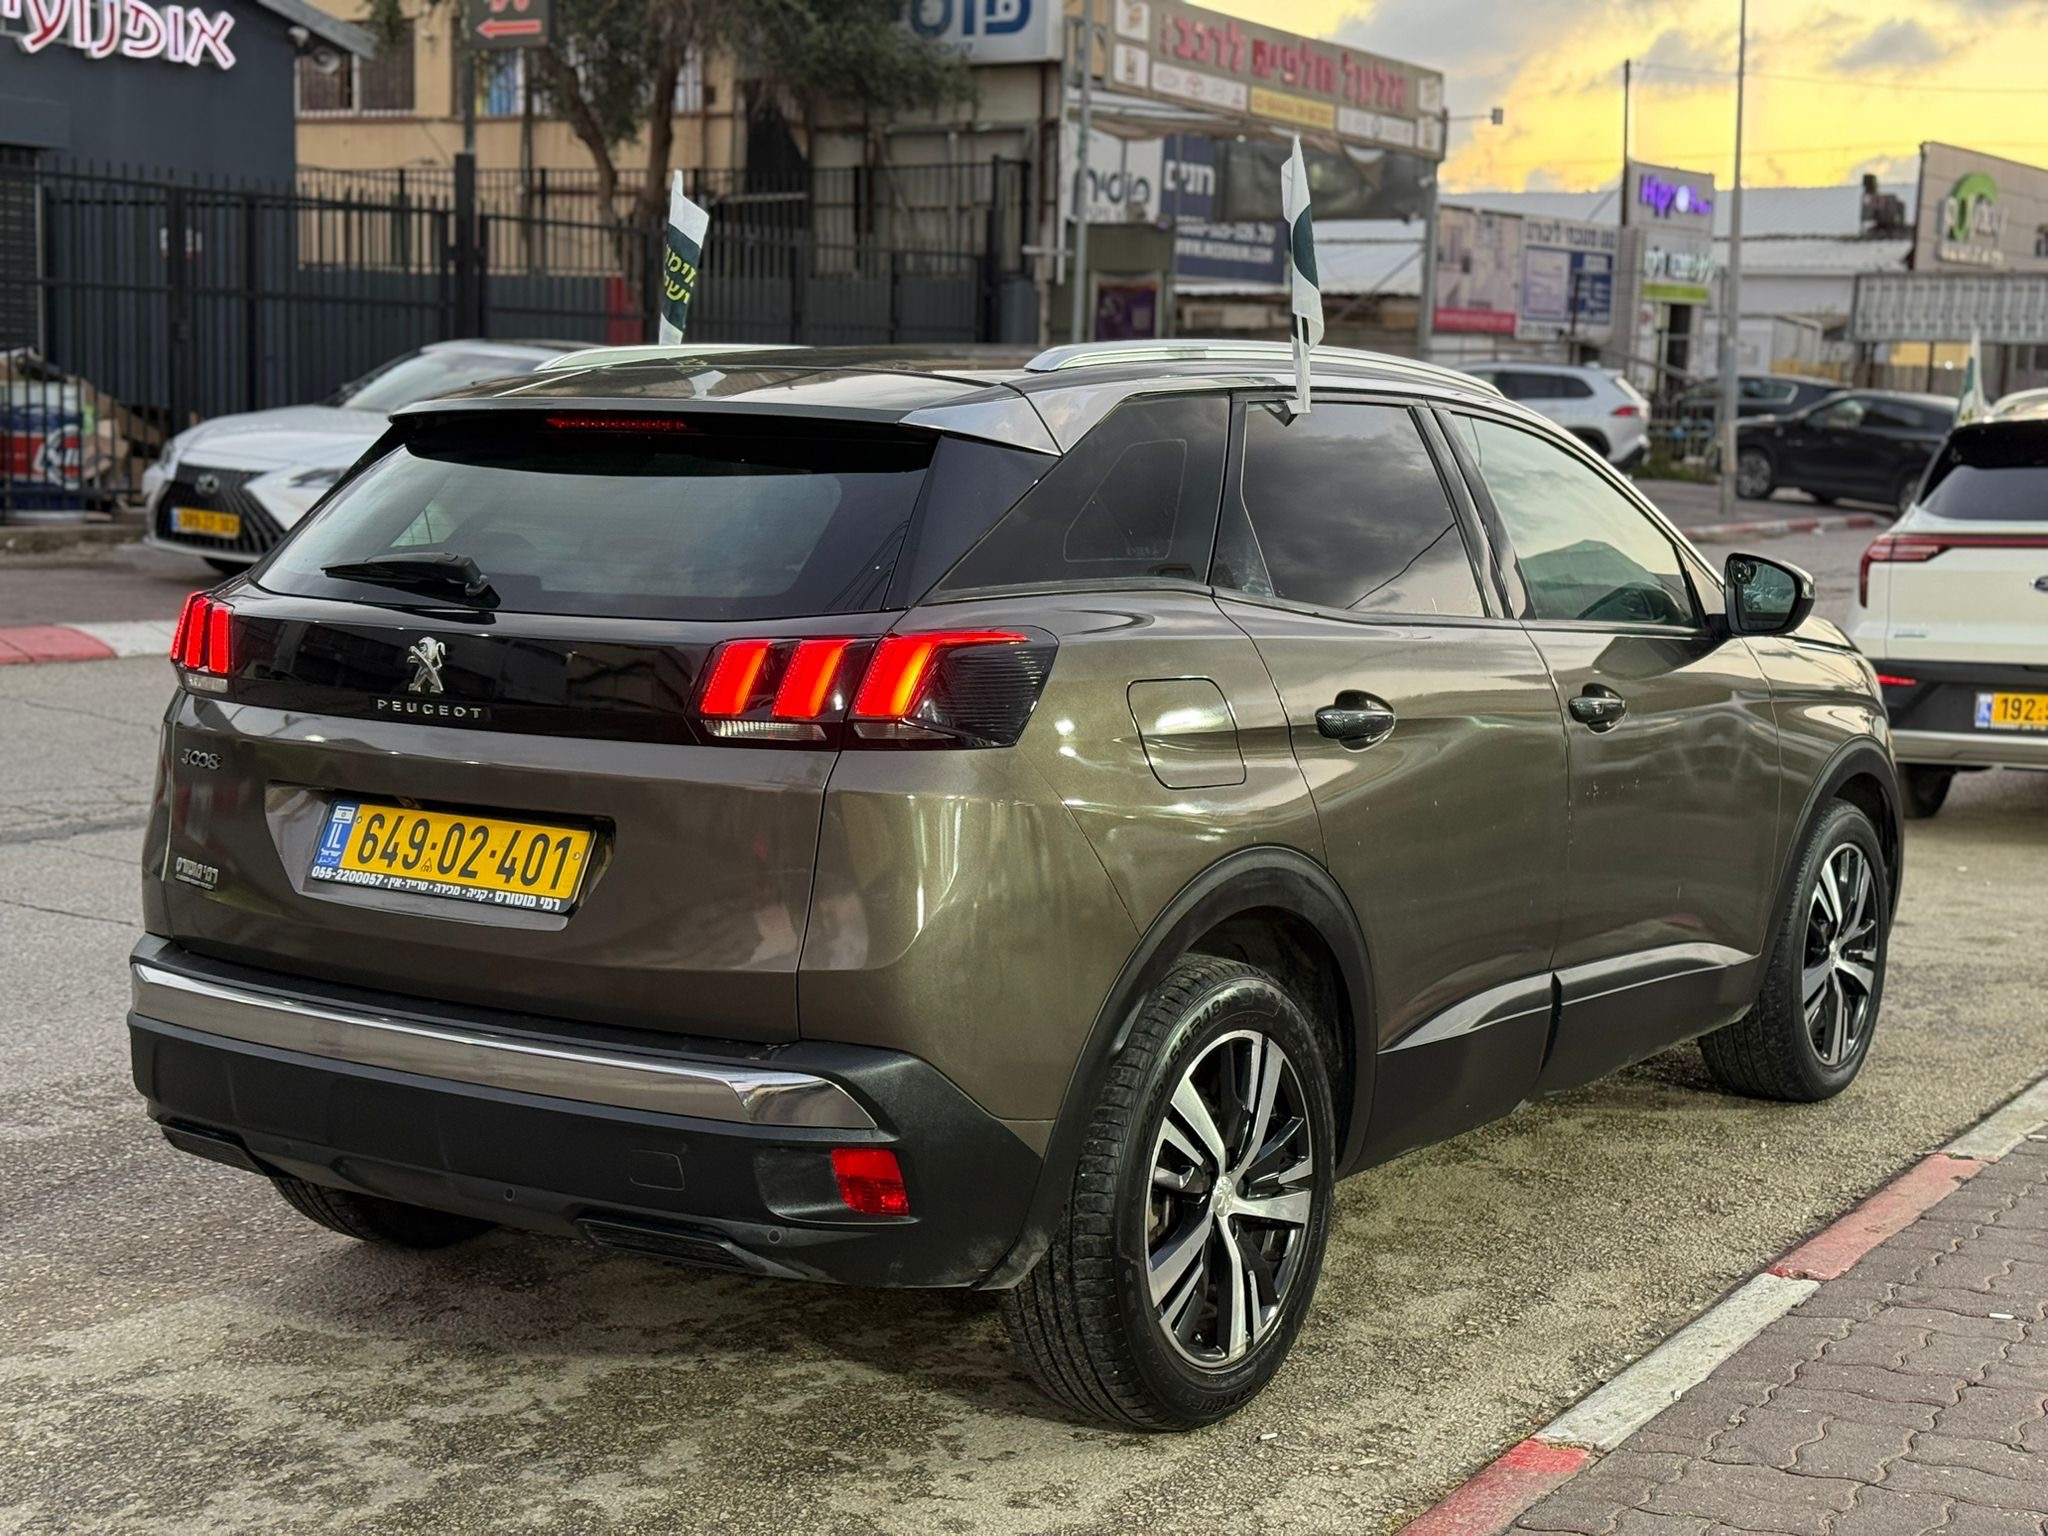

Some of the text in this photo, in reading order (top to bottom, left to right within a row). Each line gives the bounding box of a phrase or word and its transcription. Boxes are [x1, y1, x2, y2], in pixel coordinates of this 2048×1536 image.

[376, 699, 483, 719] PEUGEOT
[180, 748, 222, 770] 3008
[326, 822, 342, 849] IL
[311, 865, 384, 887] 055-2200057
[433, 882, 460, 897] מכירה
[466, 887, 489, 902] קניה
[494, 890, 537, 908] מוטורס
[539, 896, 561, 912] רמי
